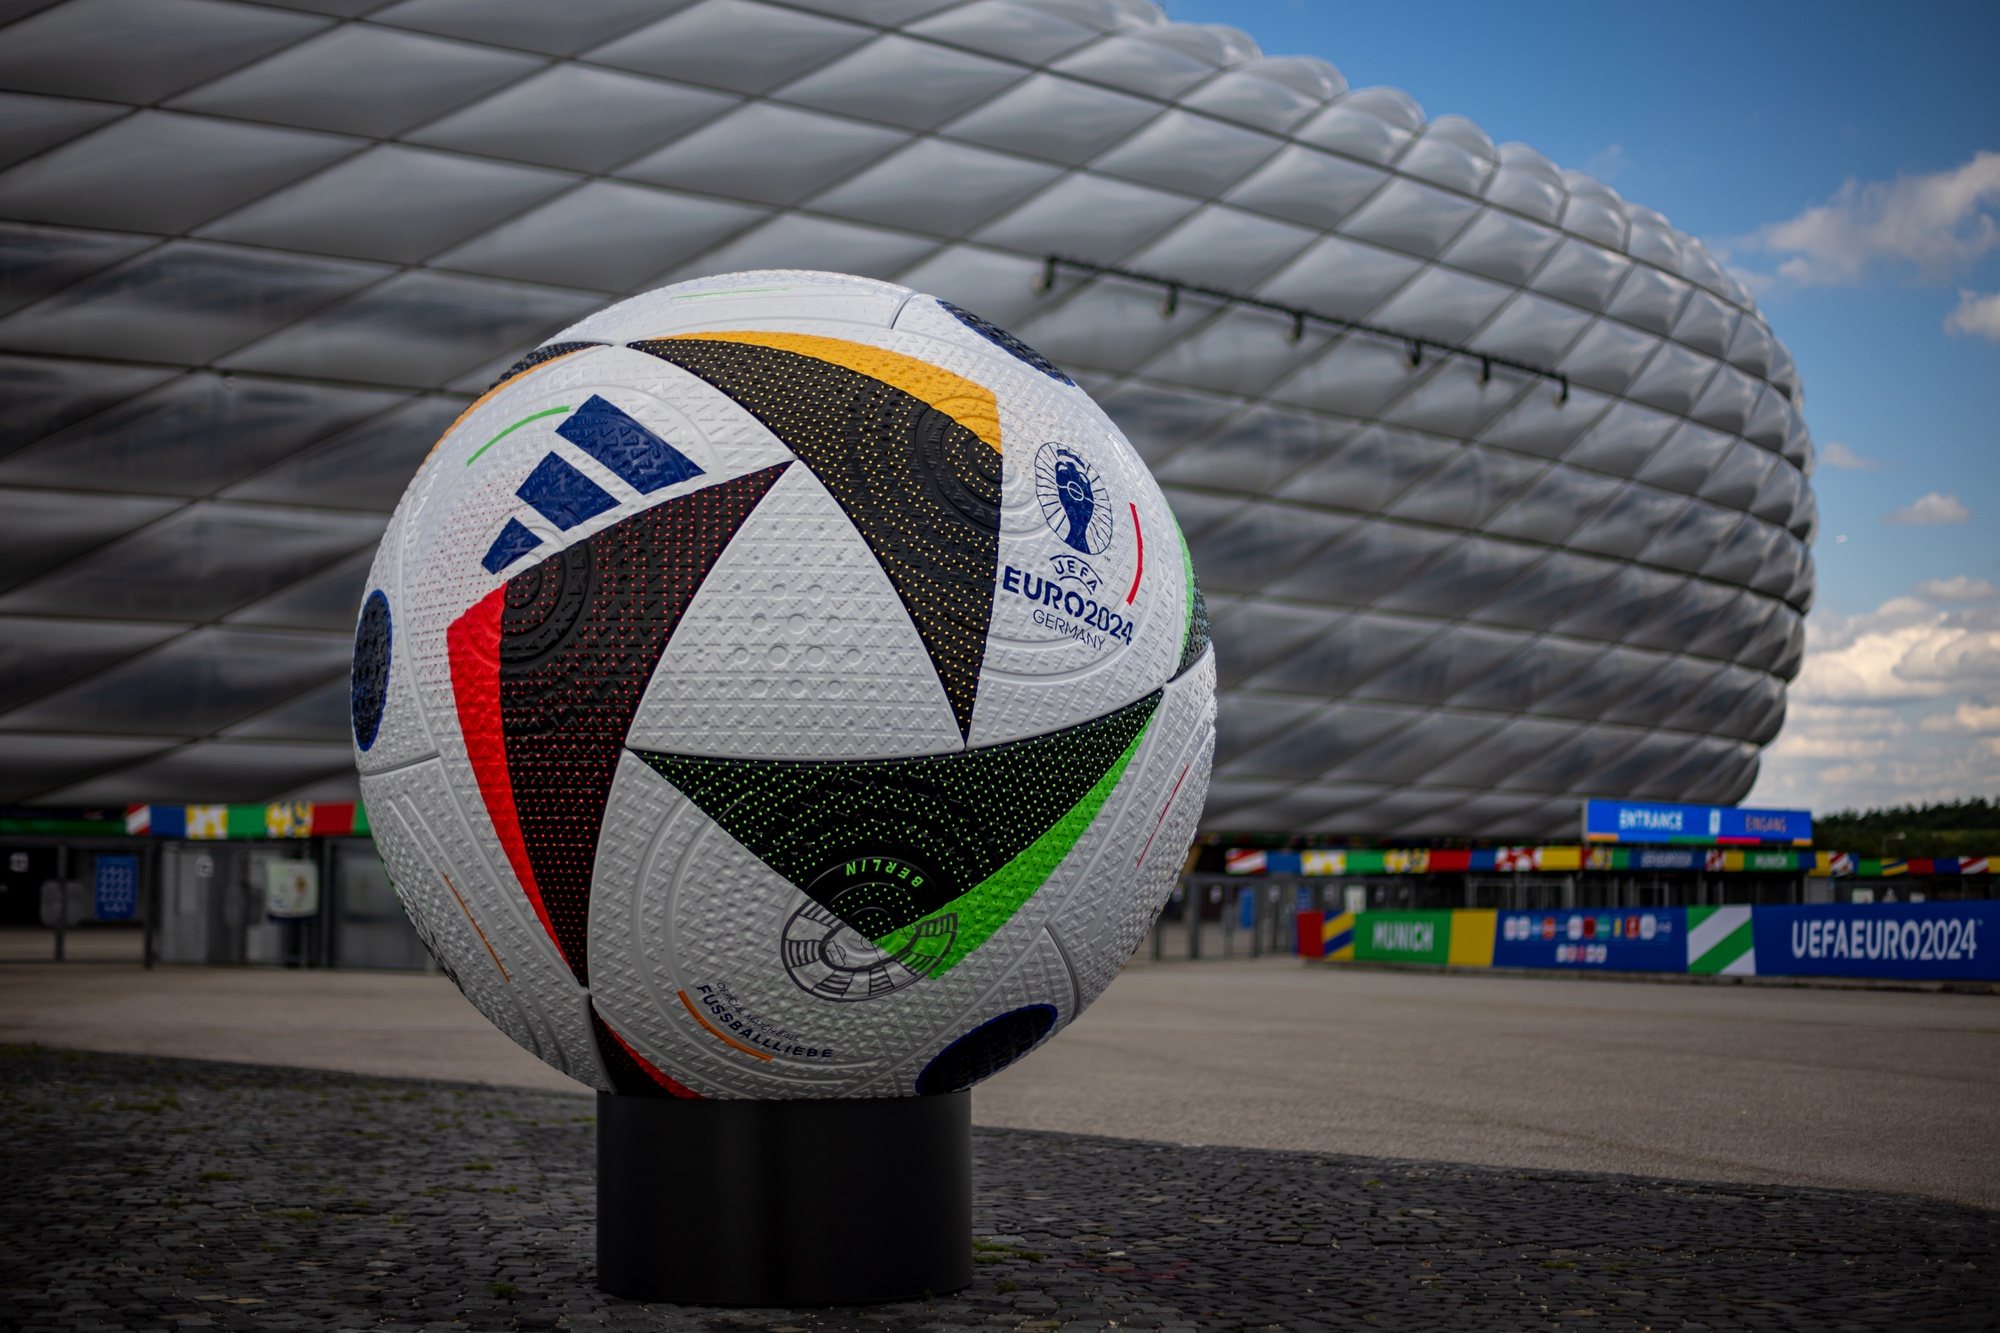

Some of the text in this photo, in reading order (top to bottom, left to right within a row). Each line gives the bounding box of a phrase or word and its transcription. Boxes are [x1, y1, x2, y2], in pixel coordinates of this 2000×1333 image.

[1033, 609, 1106, 651] GERMANY
[1619, 807, 1788, 834] ENTRANCE EINGANG
[845, 859, 924, 888] BERLIN
[1372, 921, 1434, 952] MUNICH
[697, 984, 834, 1058] FUSSBALLLIEBE
